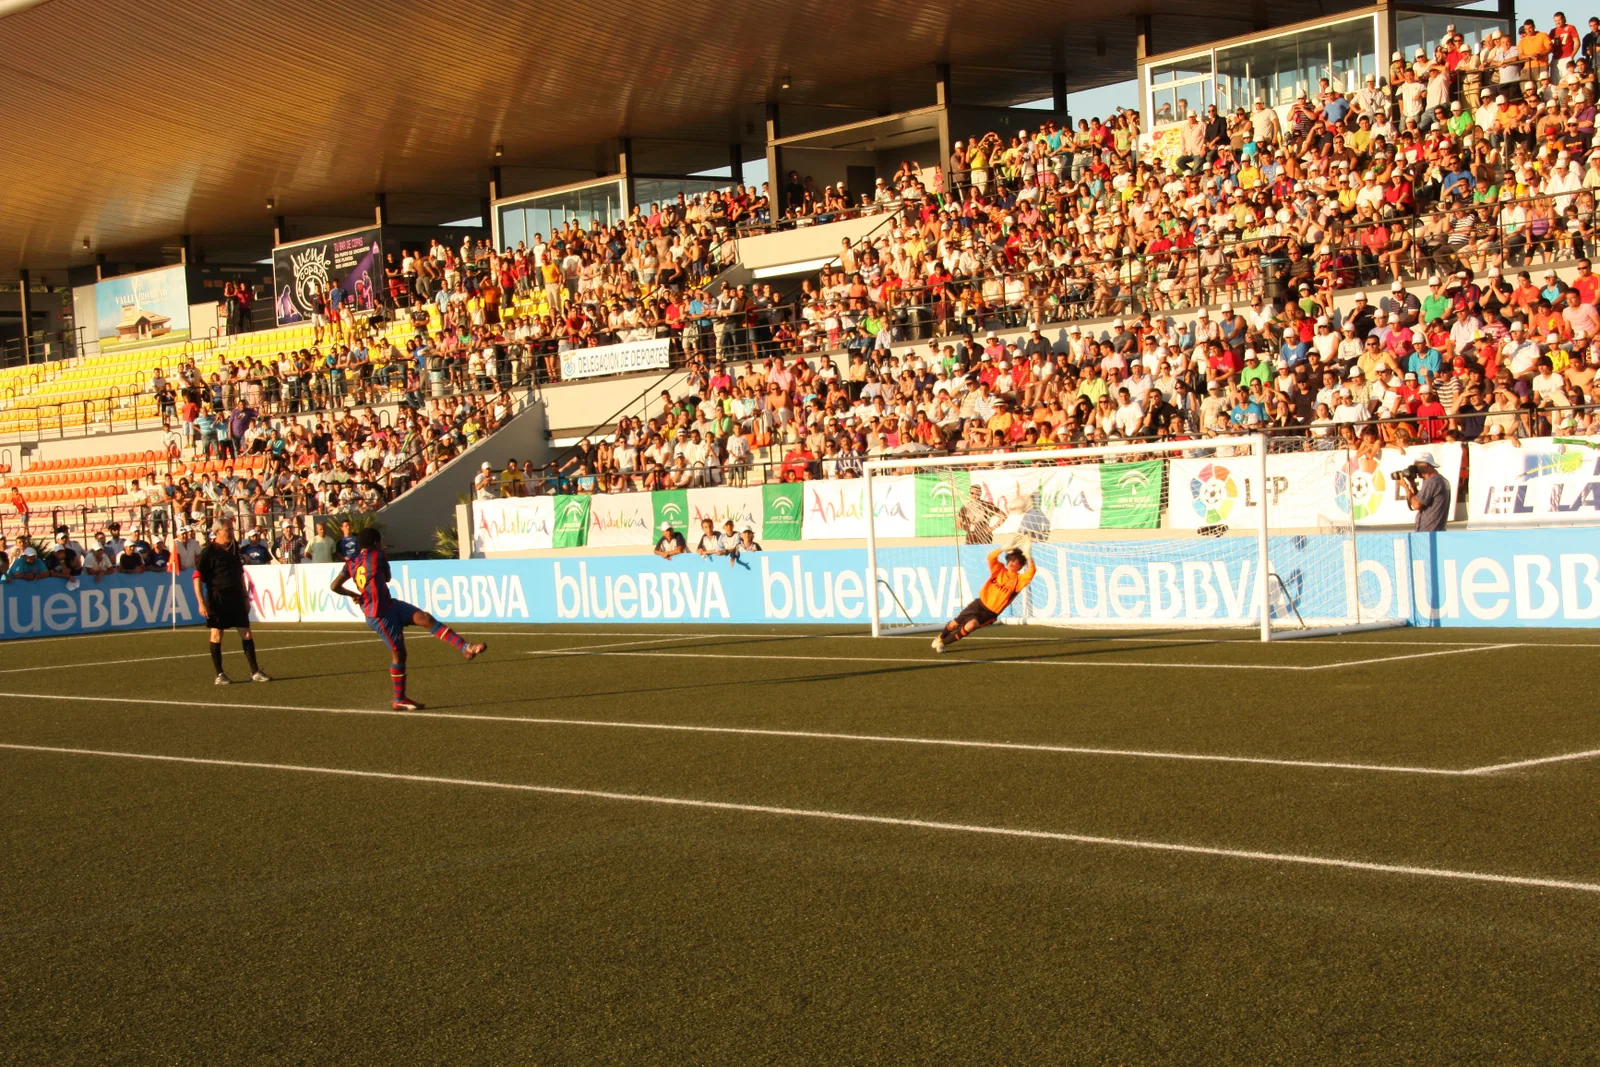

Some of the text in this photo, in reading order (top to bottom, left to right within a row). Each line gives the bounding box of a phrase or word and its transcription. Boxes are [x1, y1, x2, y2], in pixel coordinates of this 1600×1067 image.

[290, 244, 332, 277] duende
[620, 350, 630, 368] DE
[631, 345, 669, 367] DEPORTES
[479, 505, 550, 539] Andalucía
[592, 508, 648, 532] Andalucía
[356, 565, 367, 589] 6
[553, 561, 730, 619] blueBBVA
[761, 555, 975, 619] blueBBVA
